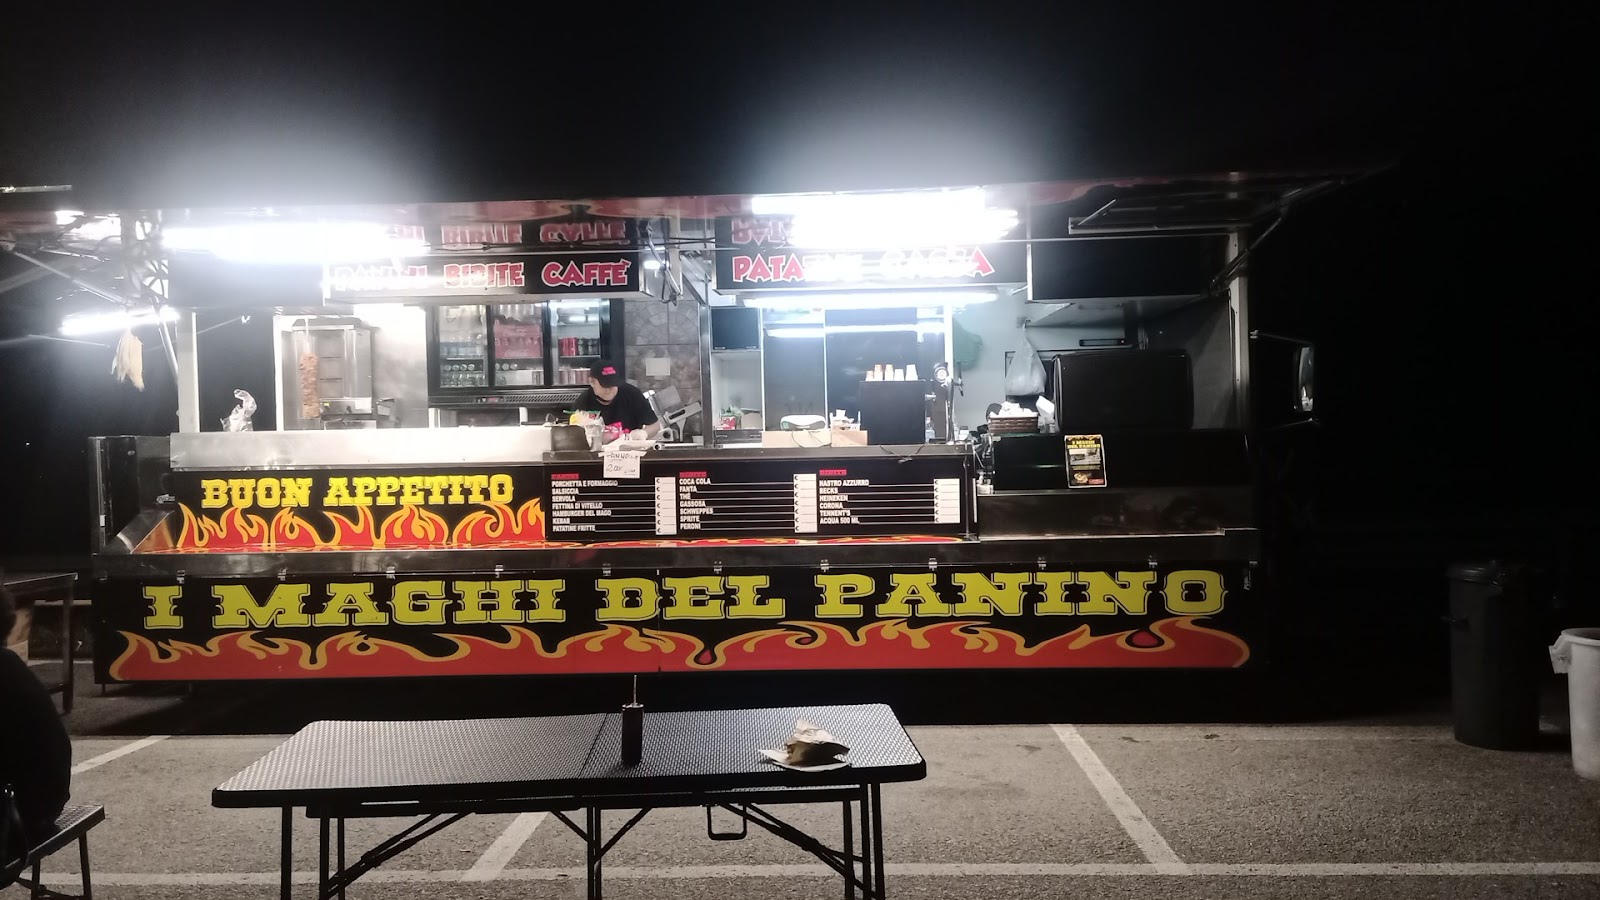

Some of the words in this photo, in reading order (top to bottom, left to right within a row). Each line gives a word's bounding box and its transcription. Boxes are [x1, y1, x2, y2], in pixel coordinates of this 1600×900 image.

[443, 261, 525, 288] BIBITE
[541, 258, 631, 287] CAFFÈ
[201, 477, 313, 508] BUON
[323, 473, 515, 506] APPETITO
[143, 584, 184, 630] I
[211, 578, 566, 629] MAGHI
[595, 573, 786, 621] DEL
[814, 569, 1228, 618] PANINO
